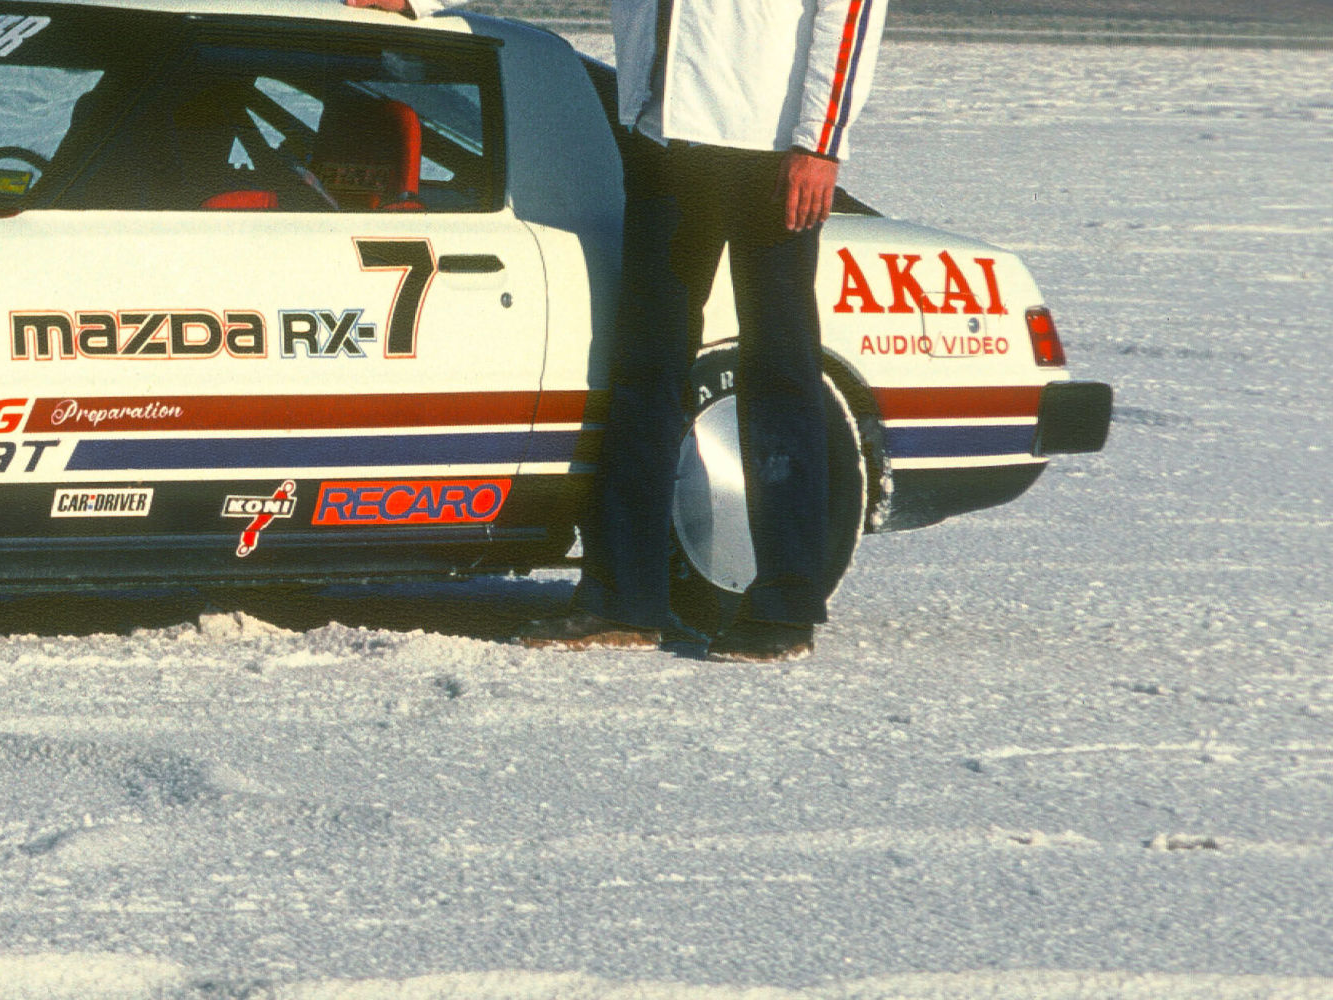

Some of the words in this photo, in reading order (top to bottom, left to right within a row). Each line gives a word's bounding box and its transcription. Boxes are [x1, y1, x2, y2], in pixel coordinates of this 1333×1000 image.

[833, 247, 1009, 315] AKAI
[9, 310, 268, 360] mazda
[51, 399, 184, 427] Preparation
[227, 500, 290, 513] KONI
[318, 483, 502, 521] RECARO
